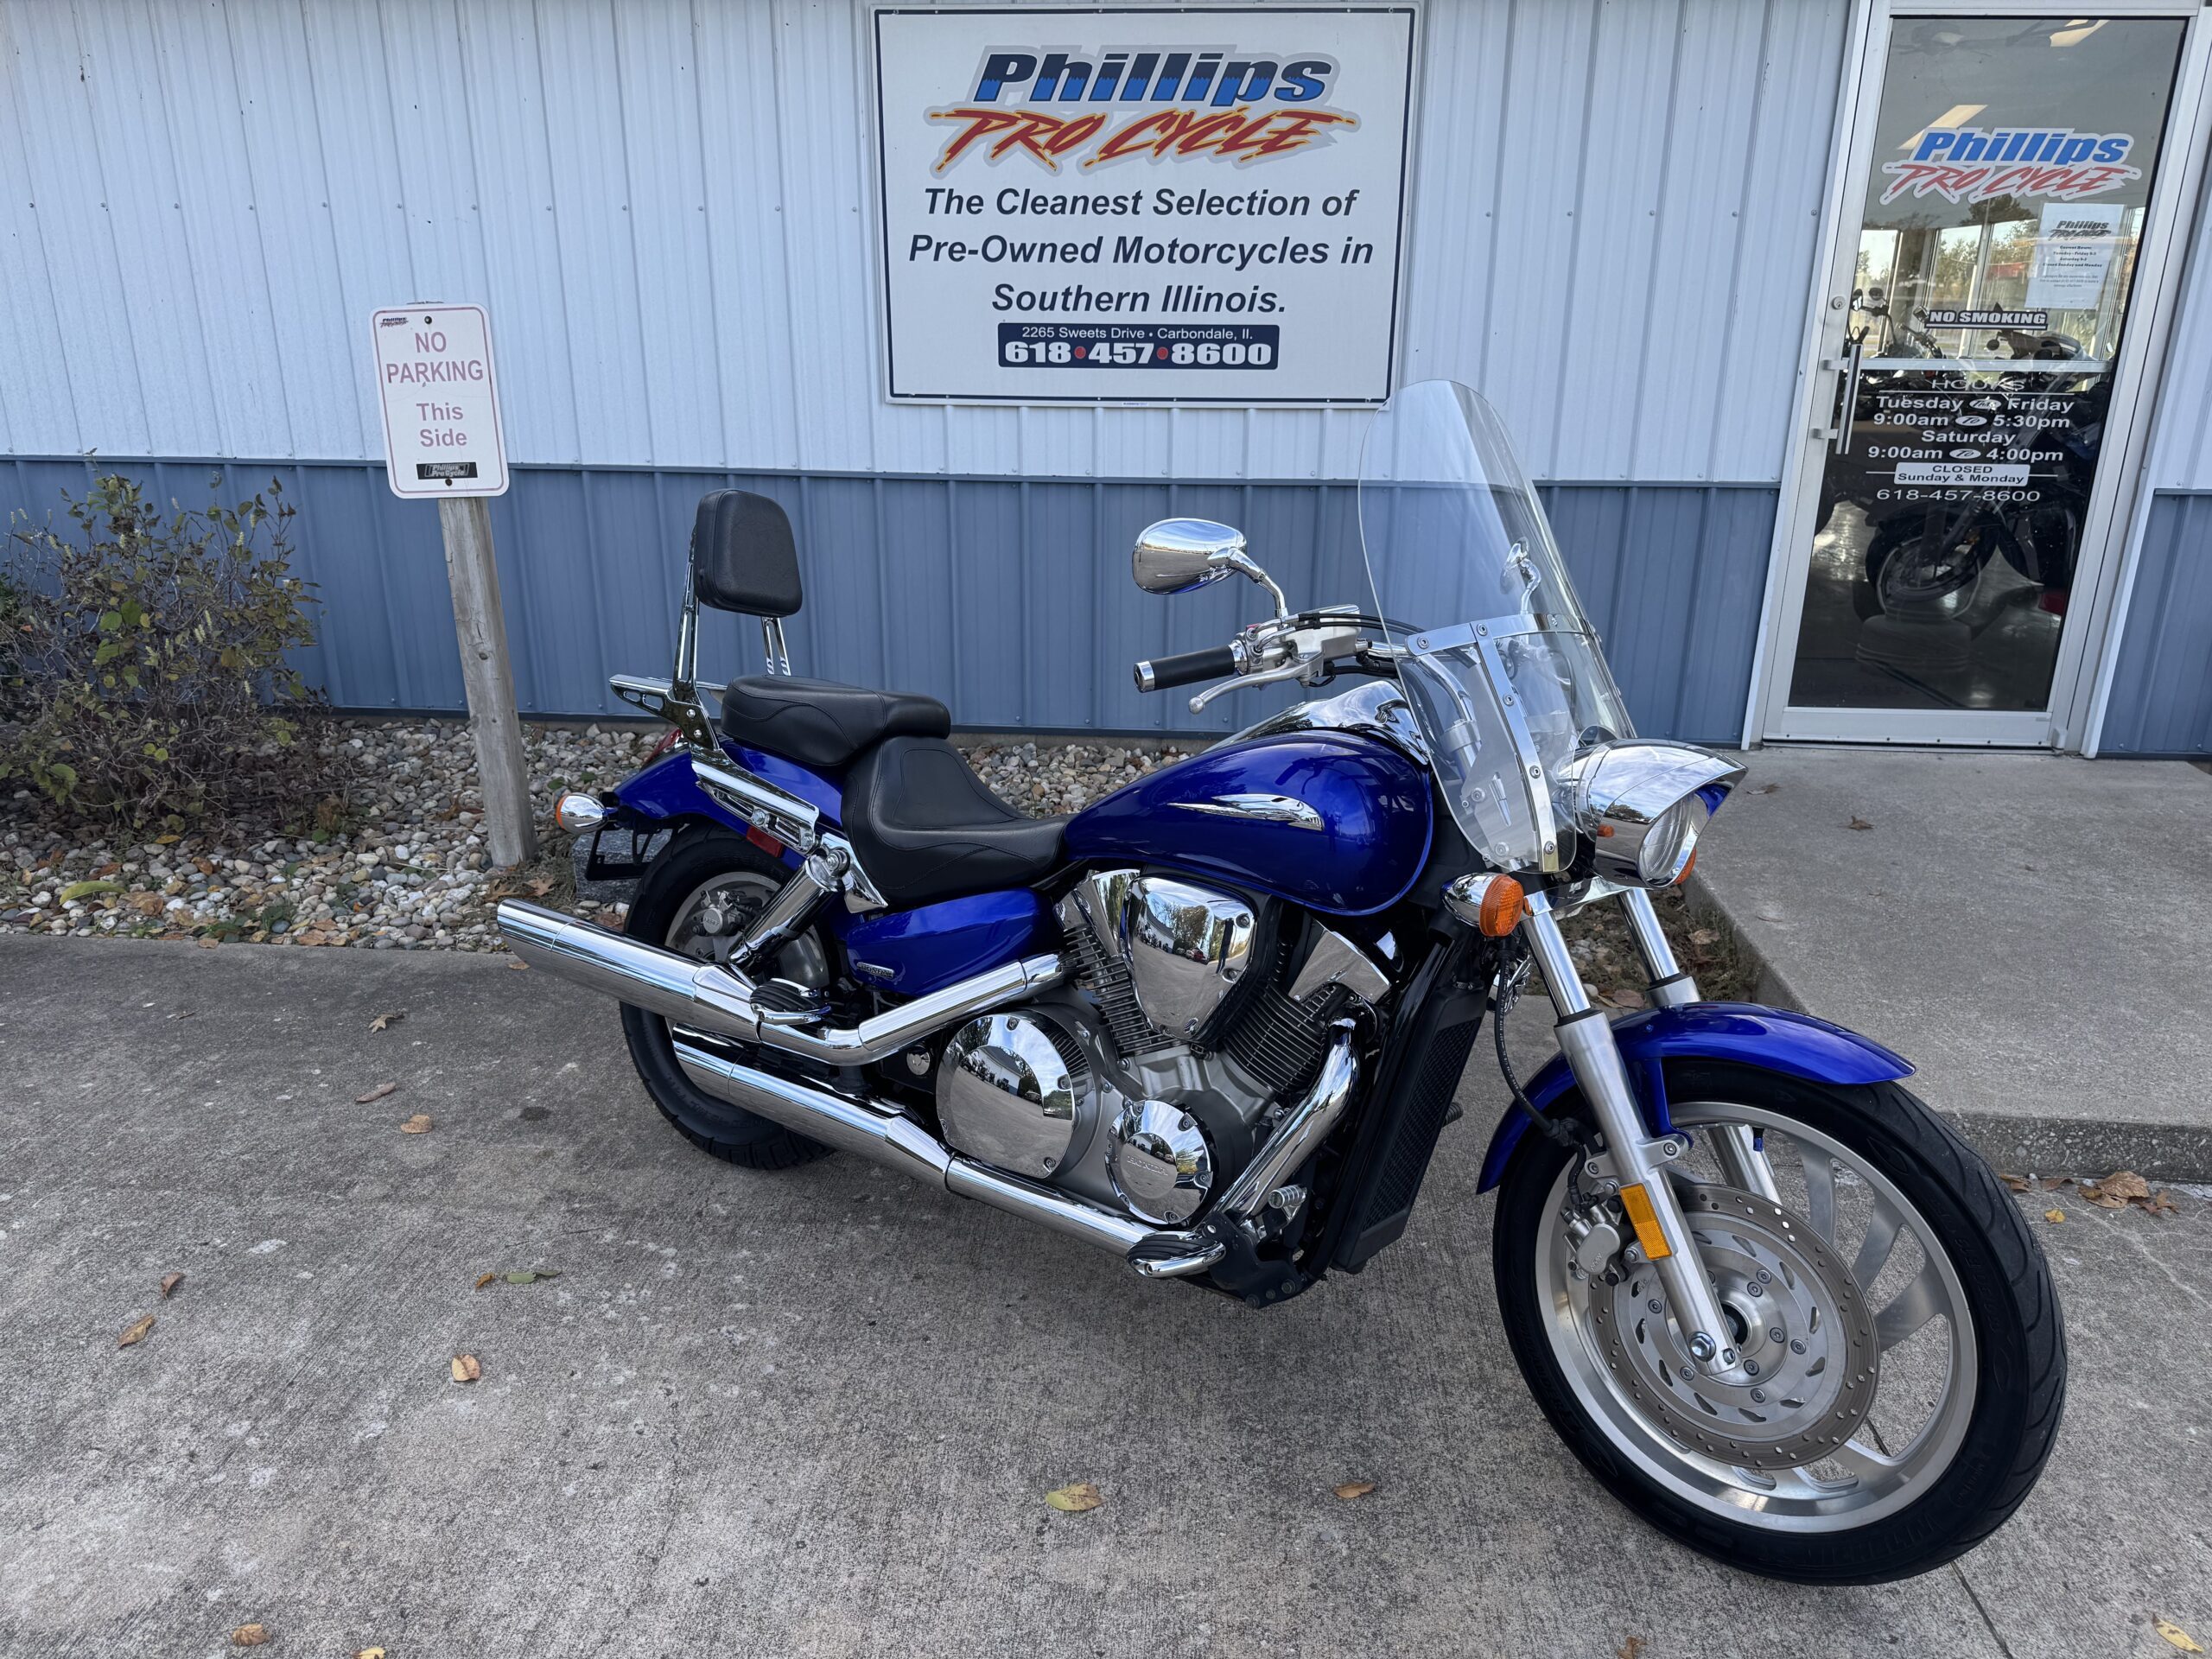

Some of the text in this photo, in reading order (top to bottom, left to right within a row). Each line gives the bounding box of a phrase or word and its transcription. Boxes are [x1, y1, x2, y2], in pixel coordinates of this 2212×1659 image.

[973, 52, 1332, 106] Phillips
[930, 105, 1357, 172] PRO CYCLE
[1913, 132, 2130, 165] Phillips
[1885, 164, 2138, 200] PRO CYCLE
[924, 188, 1361, 216] The Cleanest Selection of
[2056, 220, 2109, 229] Phillips
[909, 234, 1374, 271] Pre-Owned Motorcycles in
[991, 283, 1287, 313] Southern Illinois.
[1929, 311, 2046, 324] NO SMOKING
[415, 331, 447, 353] NO
[1022, 327, 1055, 338] 2265
[1058, 327, 1107, 339] Sweets
[1110, 327, 1145, 339] Drive
[1157, 327, 1237, 340] Carbondale,
[1005, 340, 1272, 365] 618 457 8600
[386, 359, 484, 384] PARKING
[416, 403, 464, 422] This
[1876, 396, 1964, 412] Tuesday
[2006, 397, 2074, 413] Friday
[1873, 414, 1948, 426] 9:00am
[1993, 415, 2070, 430] 5:30pm
[420, 428, 467, 448] Side
[1921, 430, 2016, 446] Saturday
[1868, 446, 1942, 459] 9:00am
[1986, 448, 2063, 463] 4:00pm
[1897, 473, 2024, 484] Sunday & Monday
[1932, 465, 1993, 474] CLOSED
[1876, 489, 2040, 502] 618-457-8600
[1127, 1155, 1169, 1177] HONDA
